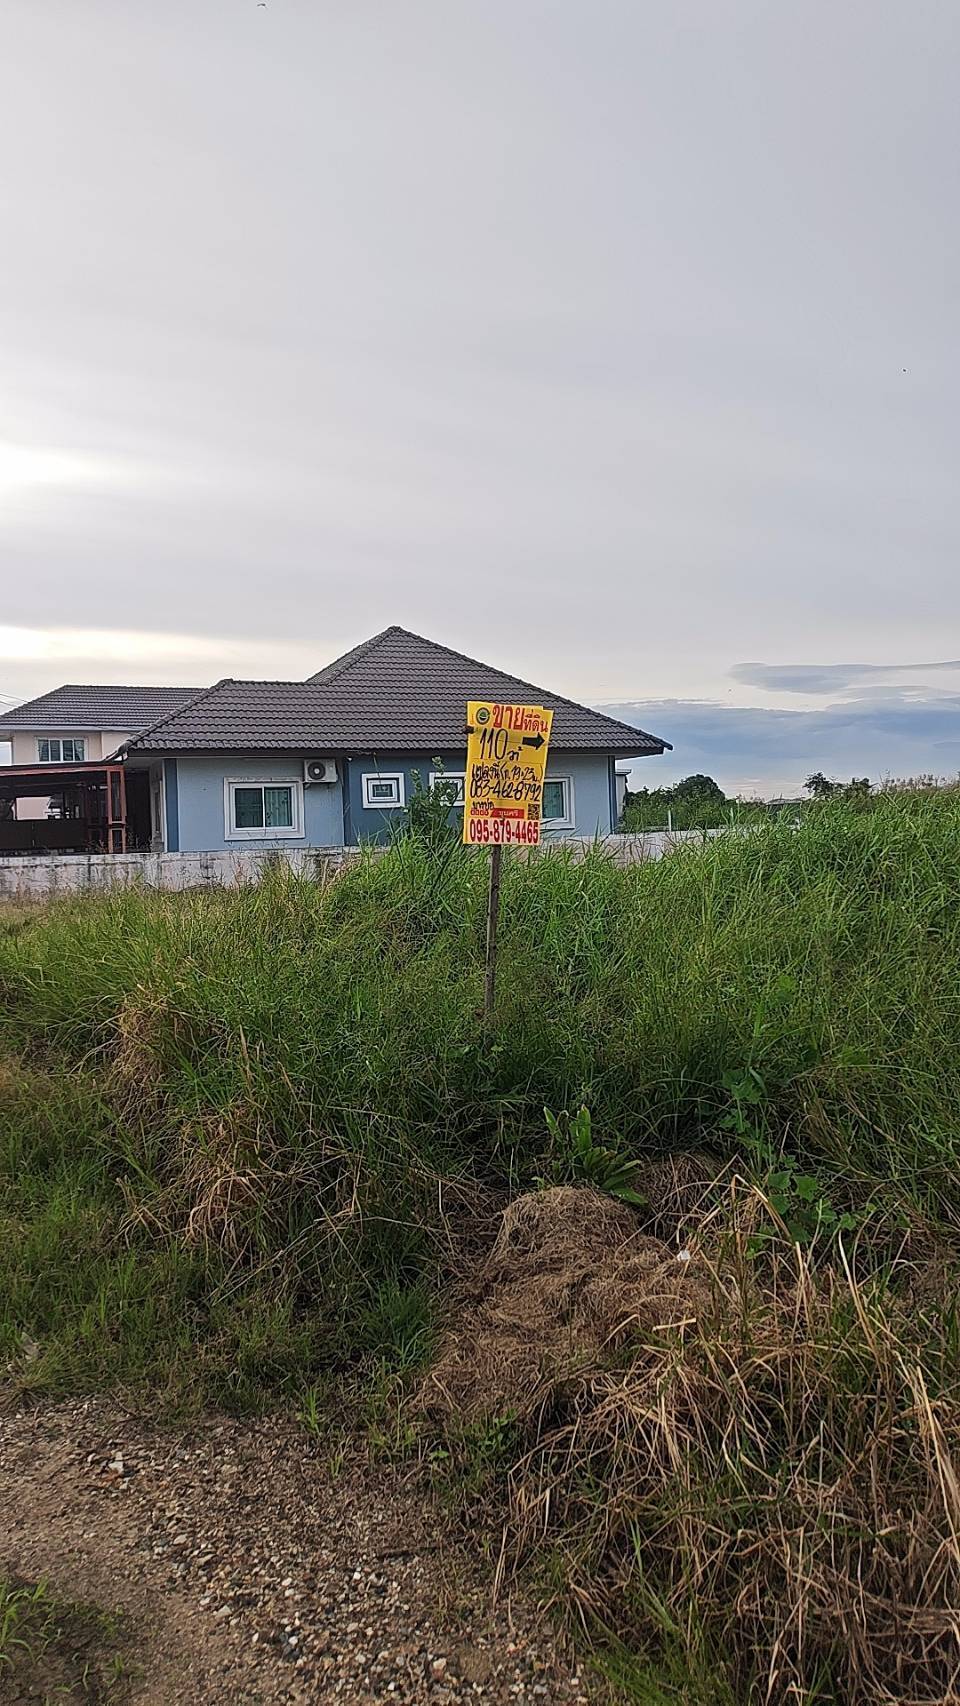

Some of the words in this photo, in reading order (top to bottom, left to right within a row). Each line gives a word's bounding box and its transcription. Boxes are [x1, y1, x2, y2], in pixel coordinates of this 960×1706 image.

[480, 727, 508, 760] 110
[470, 778, 542, 802] 083-462-8792
[469, 819, 539, 844] 095-879-4465
